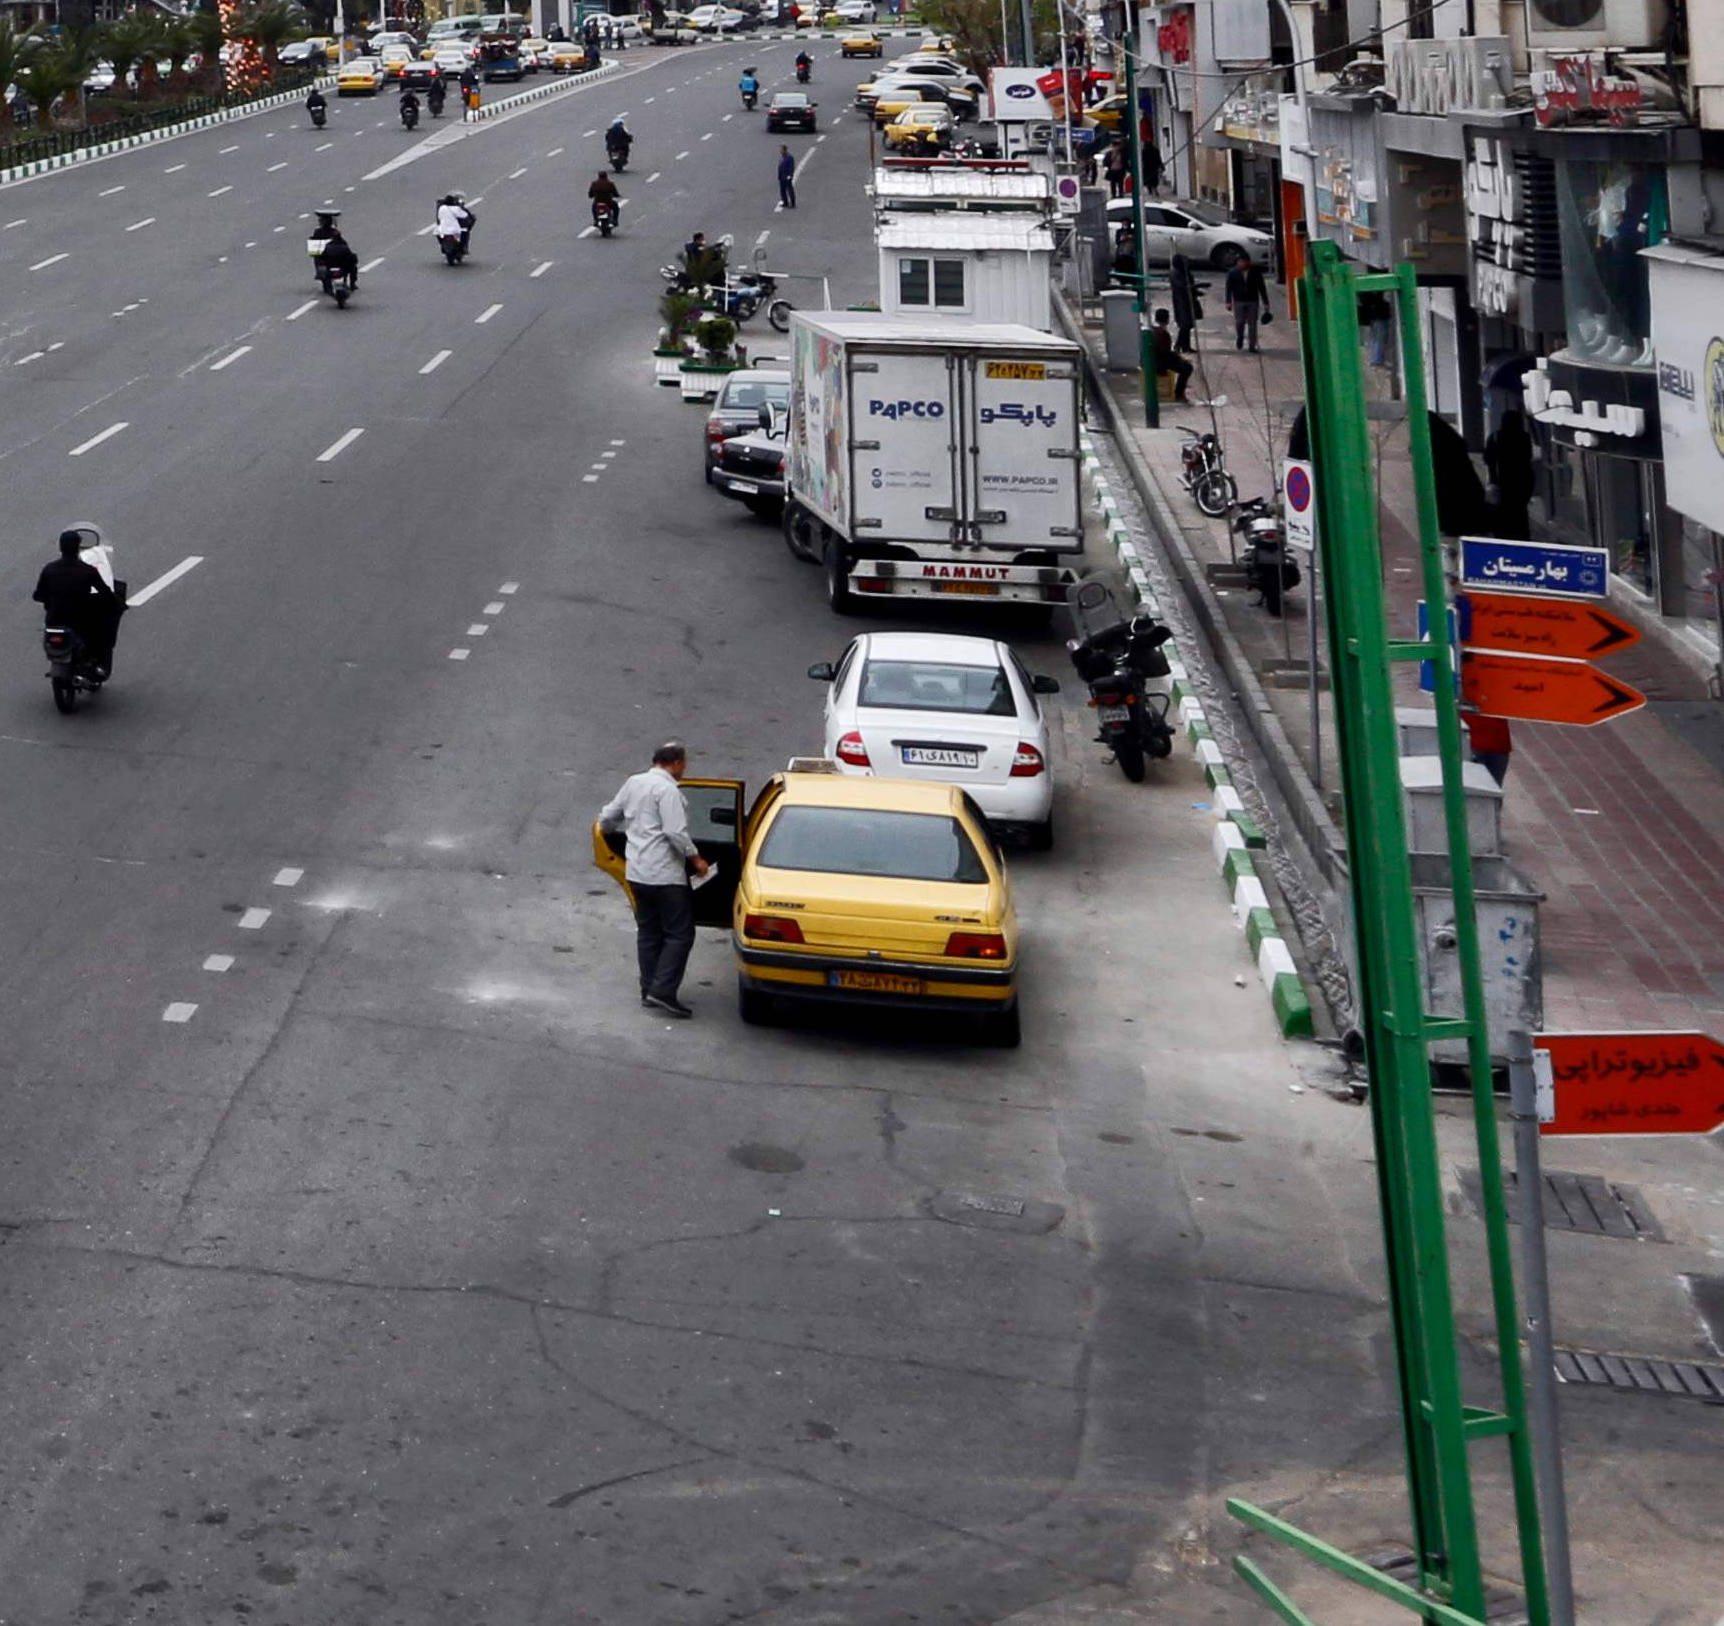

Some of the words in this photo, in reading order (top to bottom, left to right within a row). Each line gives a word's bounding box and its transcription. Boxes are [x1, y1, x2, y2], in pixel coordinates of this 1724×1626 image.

[870, 400, 944, 420] PAPCO
[980, 403, 1057, 427] پاپکو
[922, 565, 1010, 580] MAMMUT
[1553, 1046, 1701, 1085] فیزیوتراپی
